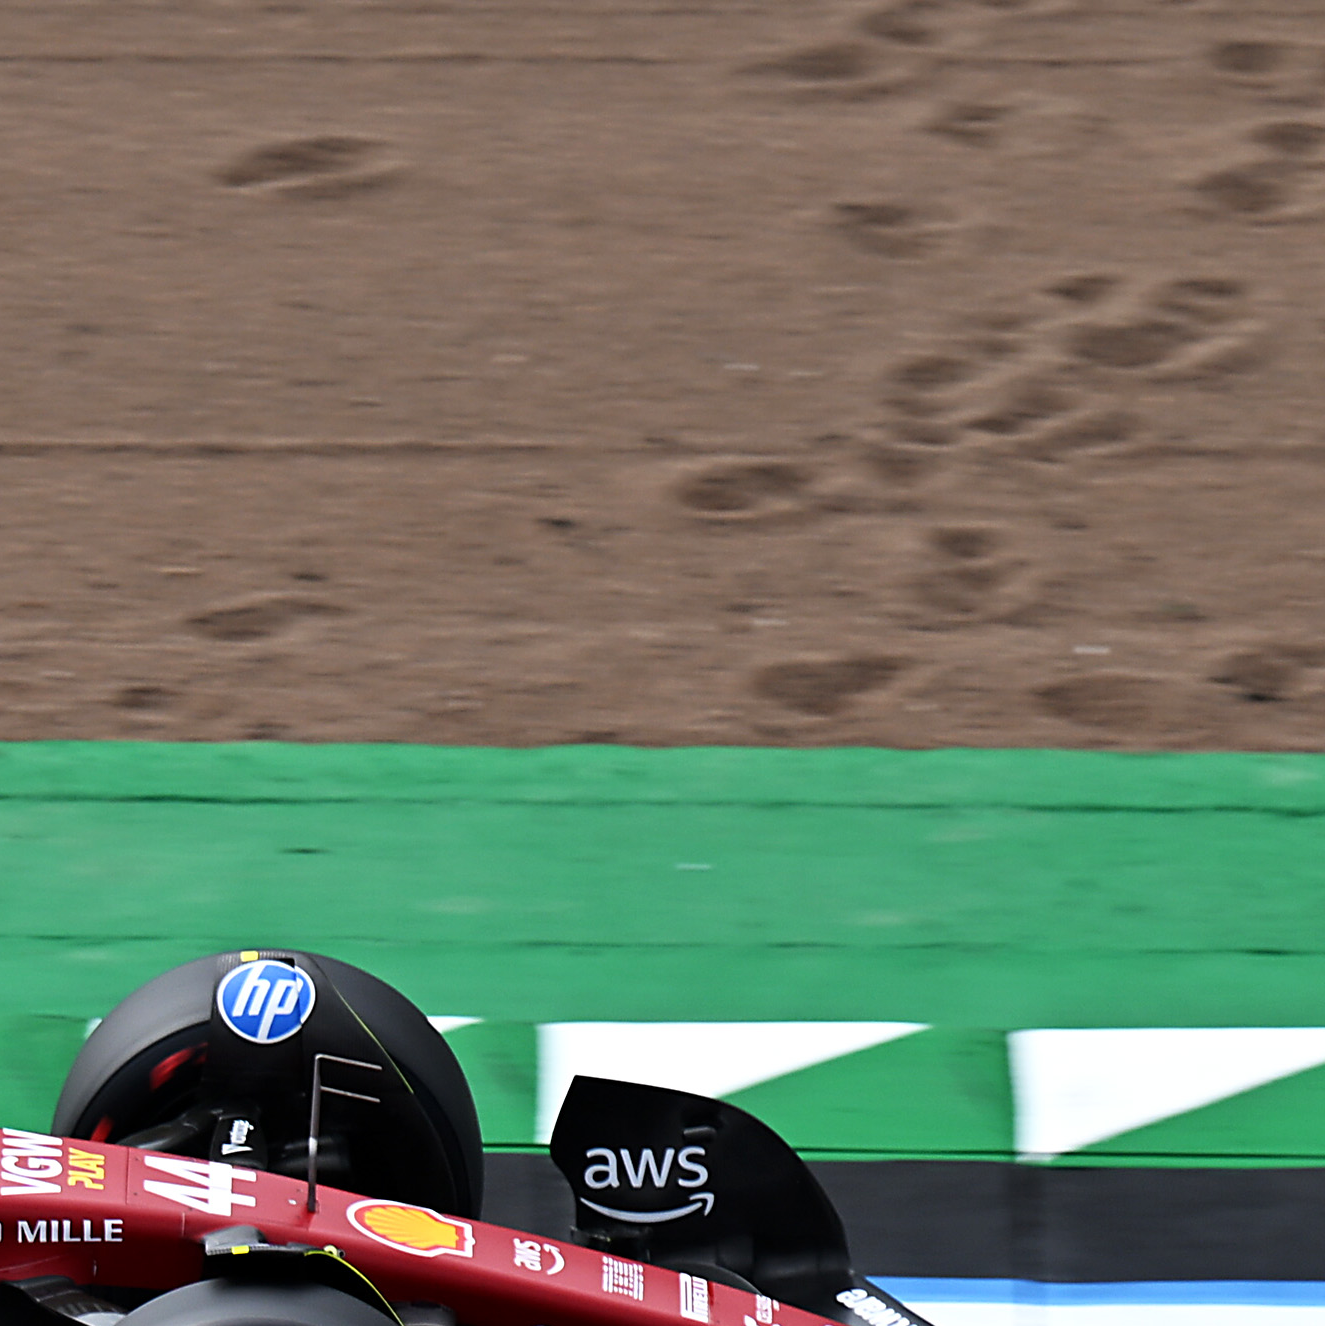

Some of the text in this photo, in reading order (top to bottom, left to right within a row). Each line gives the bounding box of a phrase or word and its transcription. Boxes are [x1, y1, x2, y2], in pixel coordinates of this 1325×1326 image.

[232, 963, 304, 1042] hp
[0, 1127, 105, 1196] VGW PLAY
[143, 1155, 256, 1217] 44
[584, 1146, 708, 1189] aws
[17, 1219, 123, 1243] MILLE
